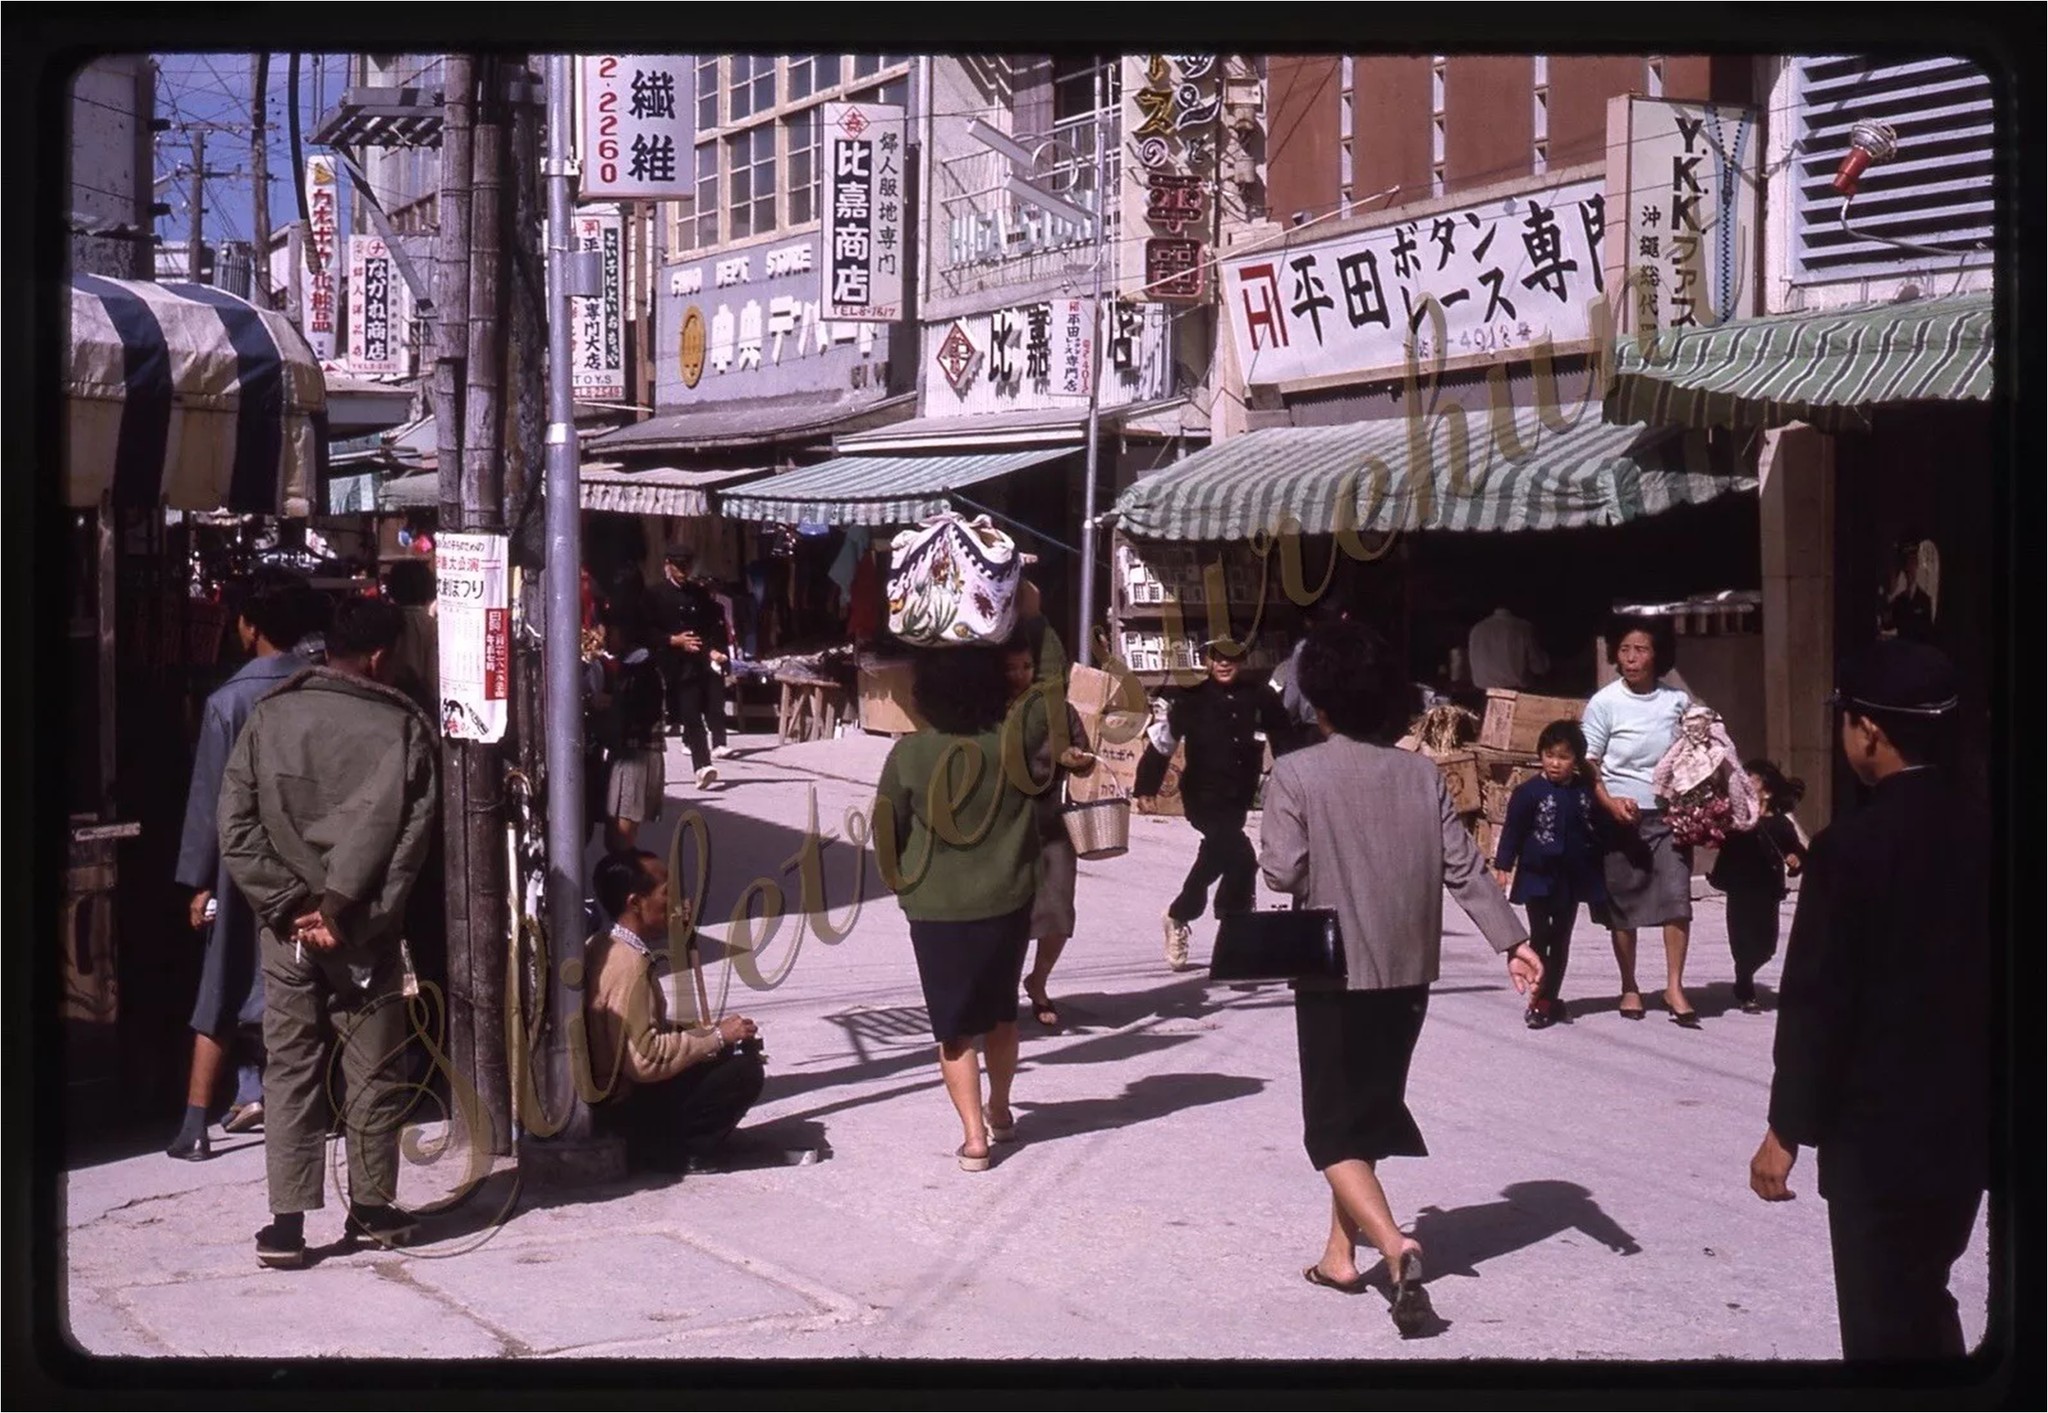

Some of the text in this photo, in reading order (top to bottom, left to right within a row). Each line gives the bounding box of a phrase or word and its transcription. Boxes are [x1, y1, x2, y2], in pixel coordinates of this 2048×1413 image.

[628, 68, 677, 182] 繊維
[834, 140, 870, 302] 比嘉商店
[1390, 212, 1498, 279] ボタン
[1289, 249, 1391, 347] 平田
[1400, 266, 1517, 335] レース
